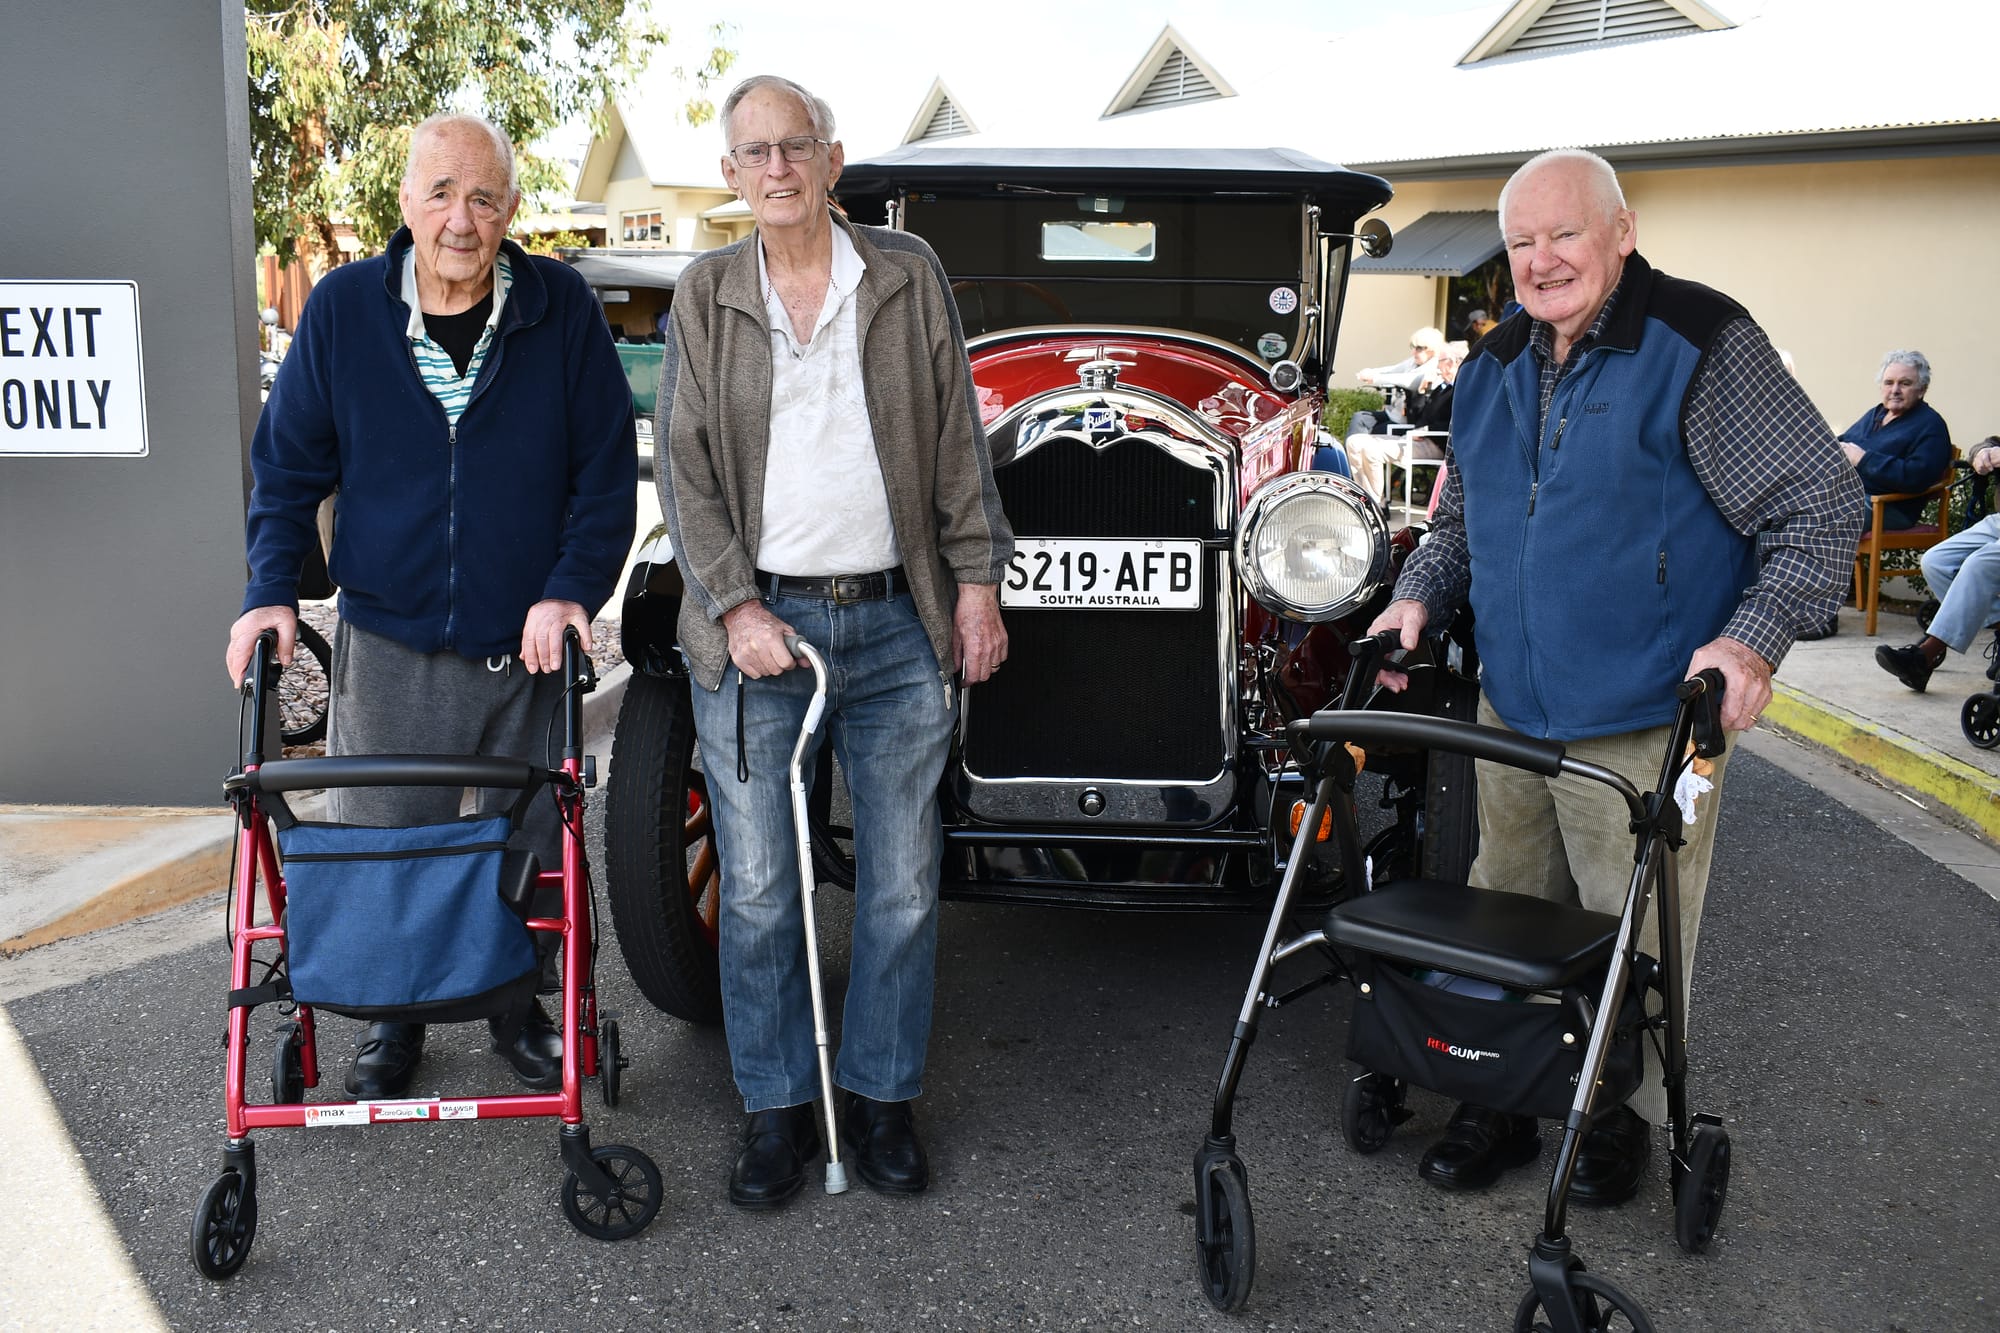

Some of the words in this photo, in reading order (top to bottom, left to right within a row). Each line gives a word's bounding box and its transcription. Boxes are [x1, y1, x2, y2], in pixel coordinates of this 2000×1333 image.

[0, 307, 102, 357] EXIT
[2, 378, 111, 430] ONLY
[1040, 594, 1083, 605] SOUTH
[1088, 595, 1160, 605] AUSTRALIA
[320, 1109, 345, 1117] max
